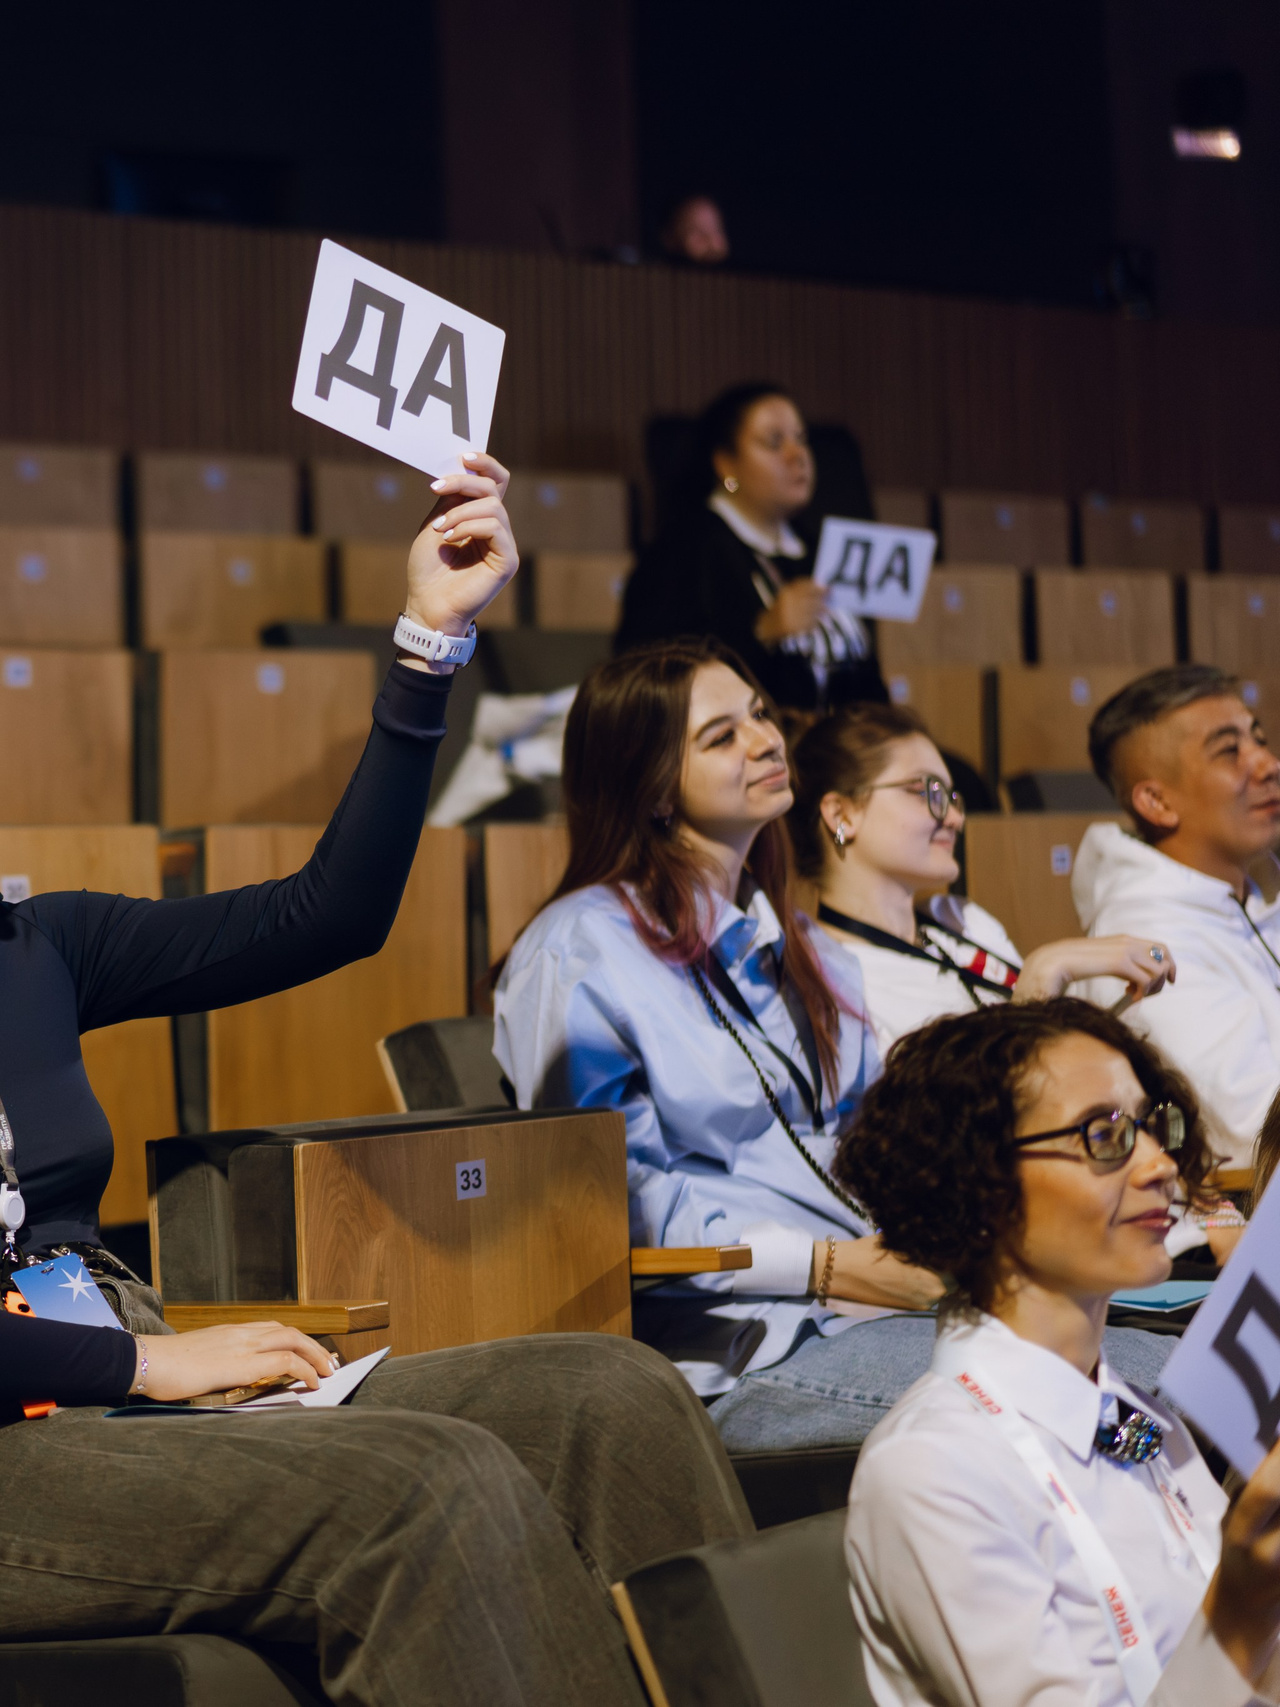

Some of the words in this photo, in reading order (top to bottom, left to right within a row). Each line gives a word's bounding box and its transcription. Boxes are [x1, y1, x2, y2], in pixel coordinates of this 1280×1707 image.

[315, 278, 471, 442] ДА
[827, 538, 910, 599] ДА
[460, 1168, 482, 1191] 33
[953, 1372, 1003, 1415] СЕНЕЖ
[1102, 1586, 1139, 1650] СЕНЕЖ
